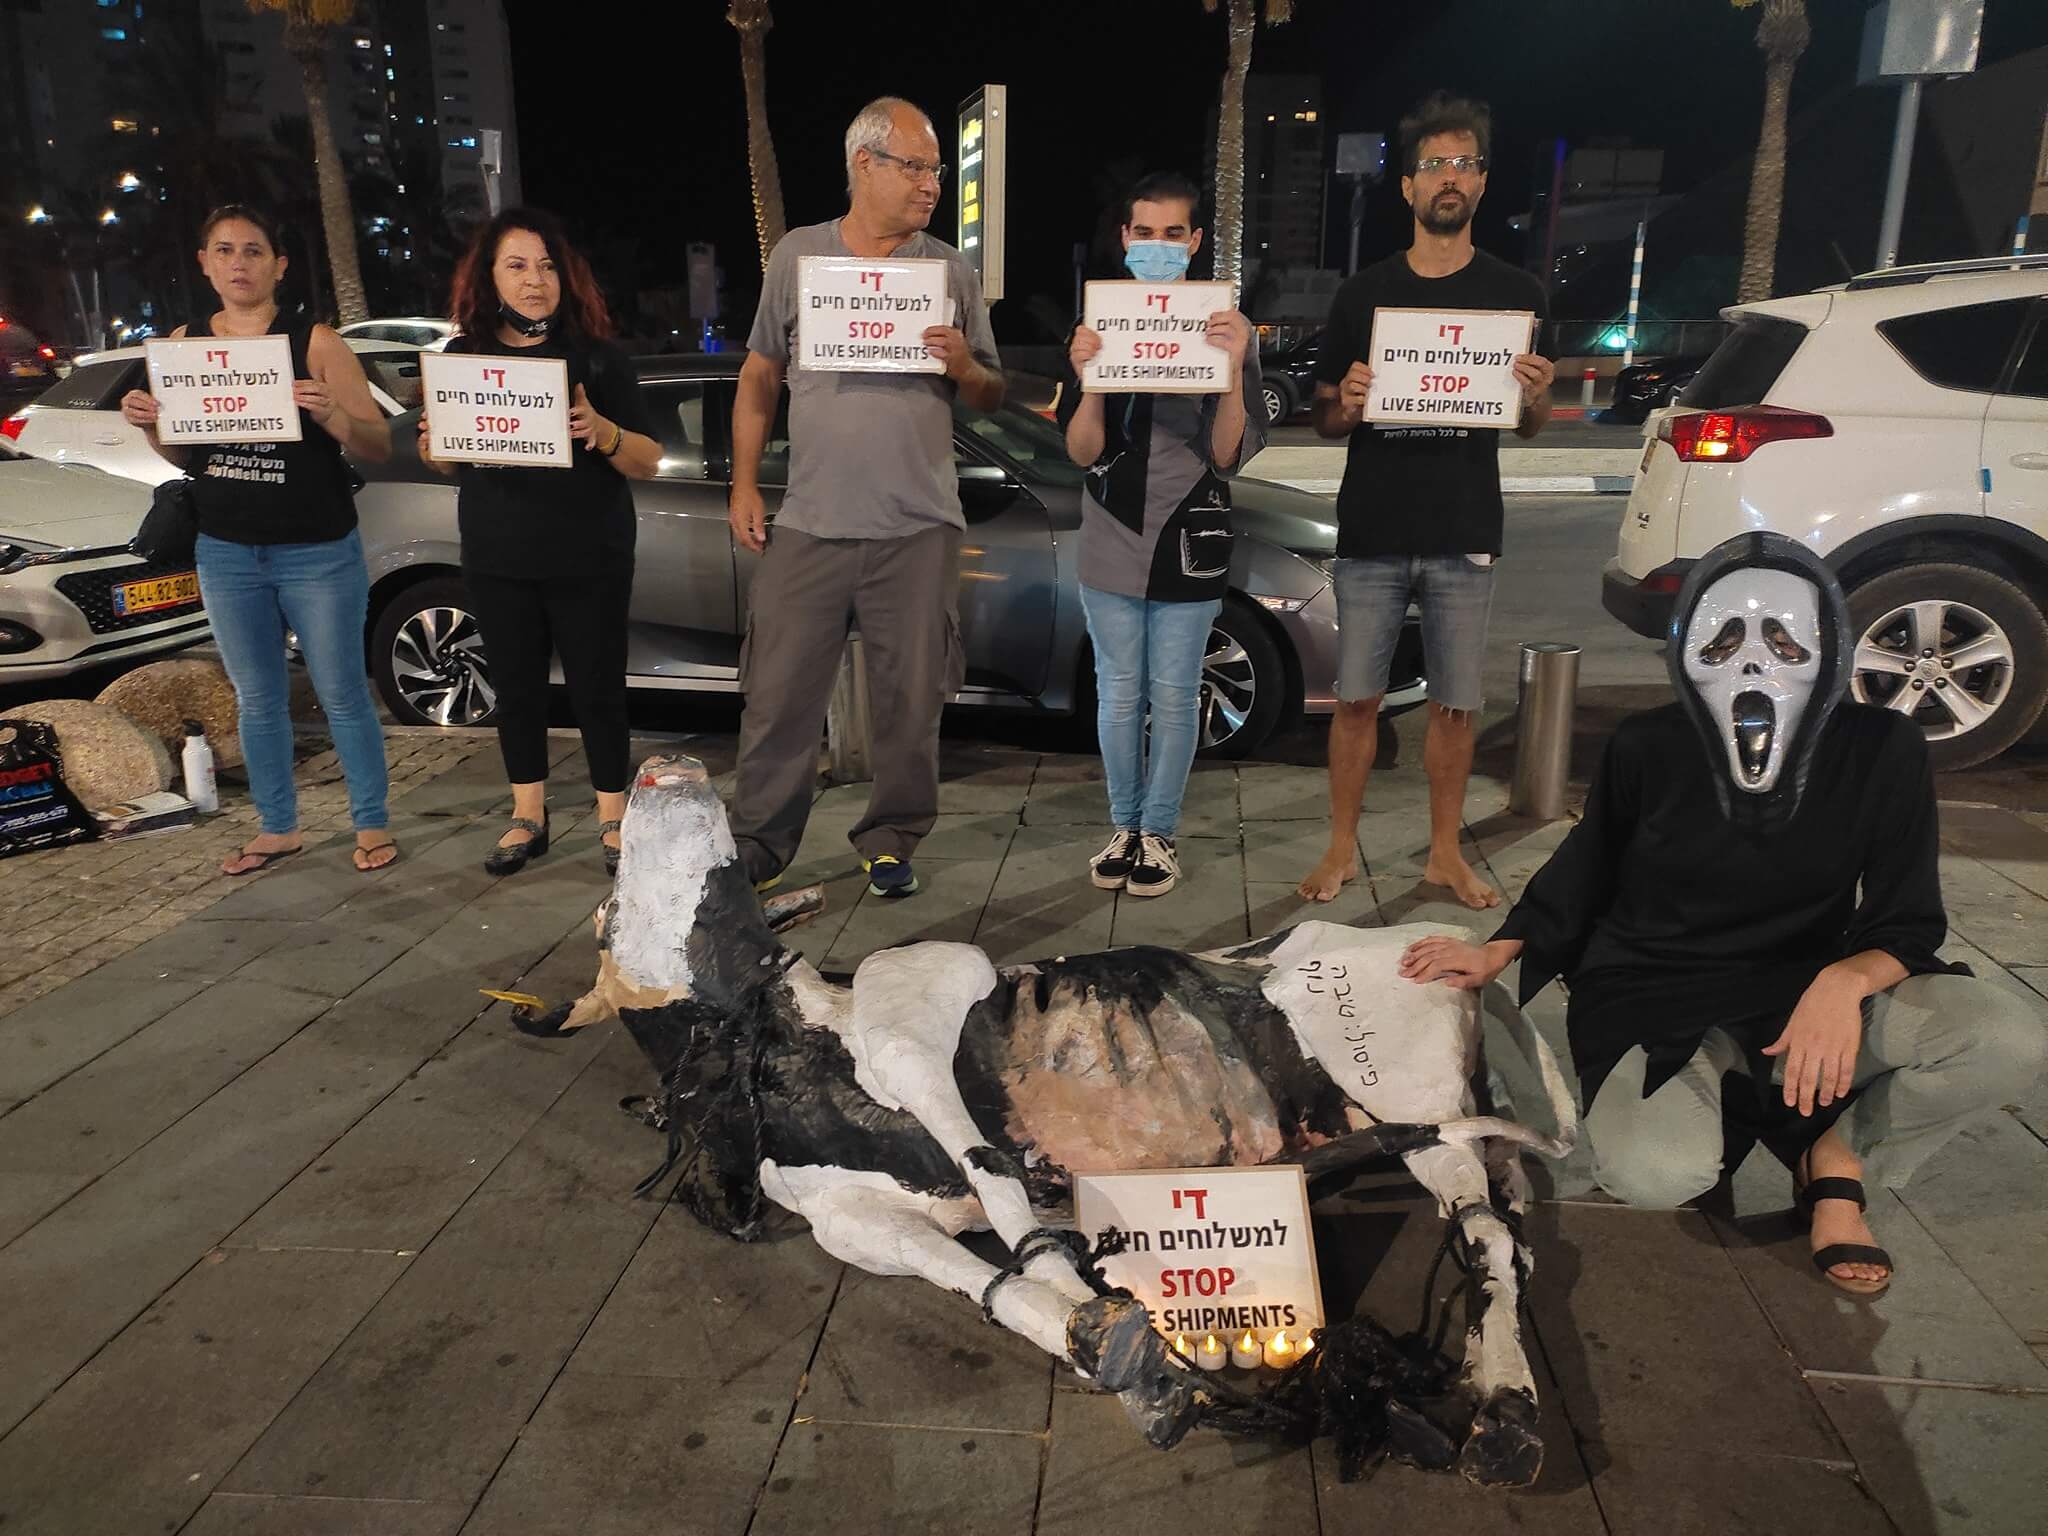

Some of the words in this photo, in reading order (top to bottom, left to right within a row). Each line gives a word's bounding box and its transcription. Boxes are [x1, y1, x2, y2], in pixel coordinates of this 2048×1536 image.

[860, 271, 885, 292] די
[811, 295, 844, 309] חיים
[850, 293, 933, 312] למשלוחים
[1146, 294, 1171, 313] די
[848, 321, 896, 339] STOP
[1097, 318, 1130, 332] חיים
[1136, 315, 1208, 333] משלוחים
[1439, 324, 1465, 346] די
[206, 350, 229, 369] די
[814, 344, 845, 358] LIVE
[848, 344, 929, 360] SHIPMENTS
[1133, 342, 1181, 359] STOP
[1384, 348, 1419, 363] חיים
[1425, 347, 1513, 367] למשלוחים
[162, 374, 196, 388] חיים
[200, 368, 279, 387] למשלוחים
[482, 368, 506, 389] די
[1098, 365, 1129, 379] LIVE
[1132, 365, 1215, 380] SHIPMENTS
[1420, 374, 1470, 394] STOP
[202, 396, 248, 414] STOP
[436, 390, 469, 404] חיים
[475, 389, 554, 409] למשלוחים
[1382, 397, 1414, 412] LIVE
[1417, 398, 1504, 416] SHIPMENTS
[172, 419, 203, 433] LIVE
[205, 417, 285, 433] SHIPMENTS
[475, 415, 521, 434] STOP
[443, 436, 474, 451] LIVE
[477, 438, 556, 455] SHIPMENTS
[1171, 1189, 1208, 1220] די
[1159, 1219, 1288, 1250] למשלוחים
[1160, 1267, 1236, 1298] STOP
[1163, 1304, 1297, 1332] SHIPMENTS
